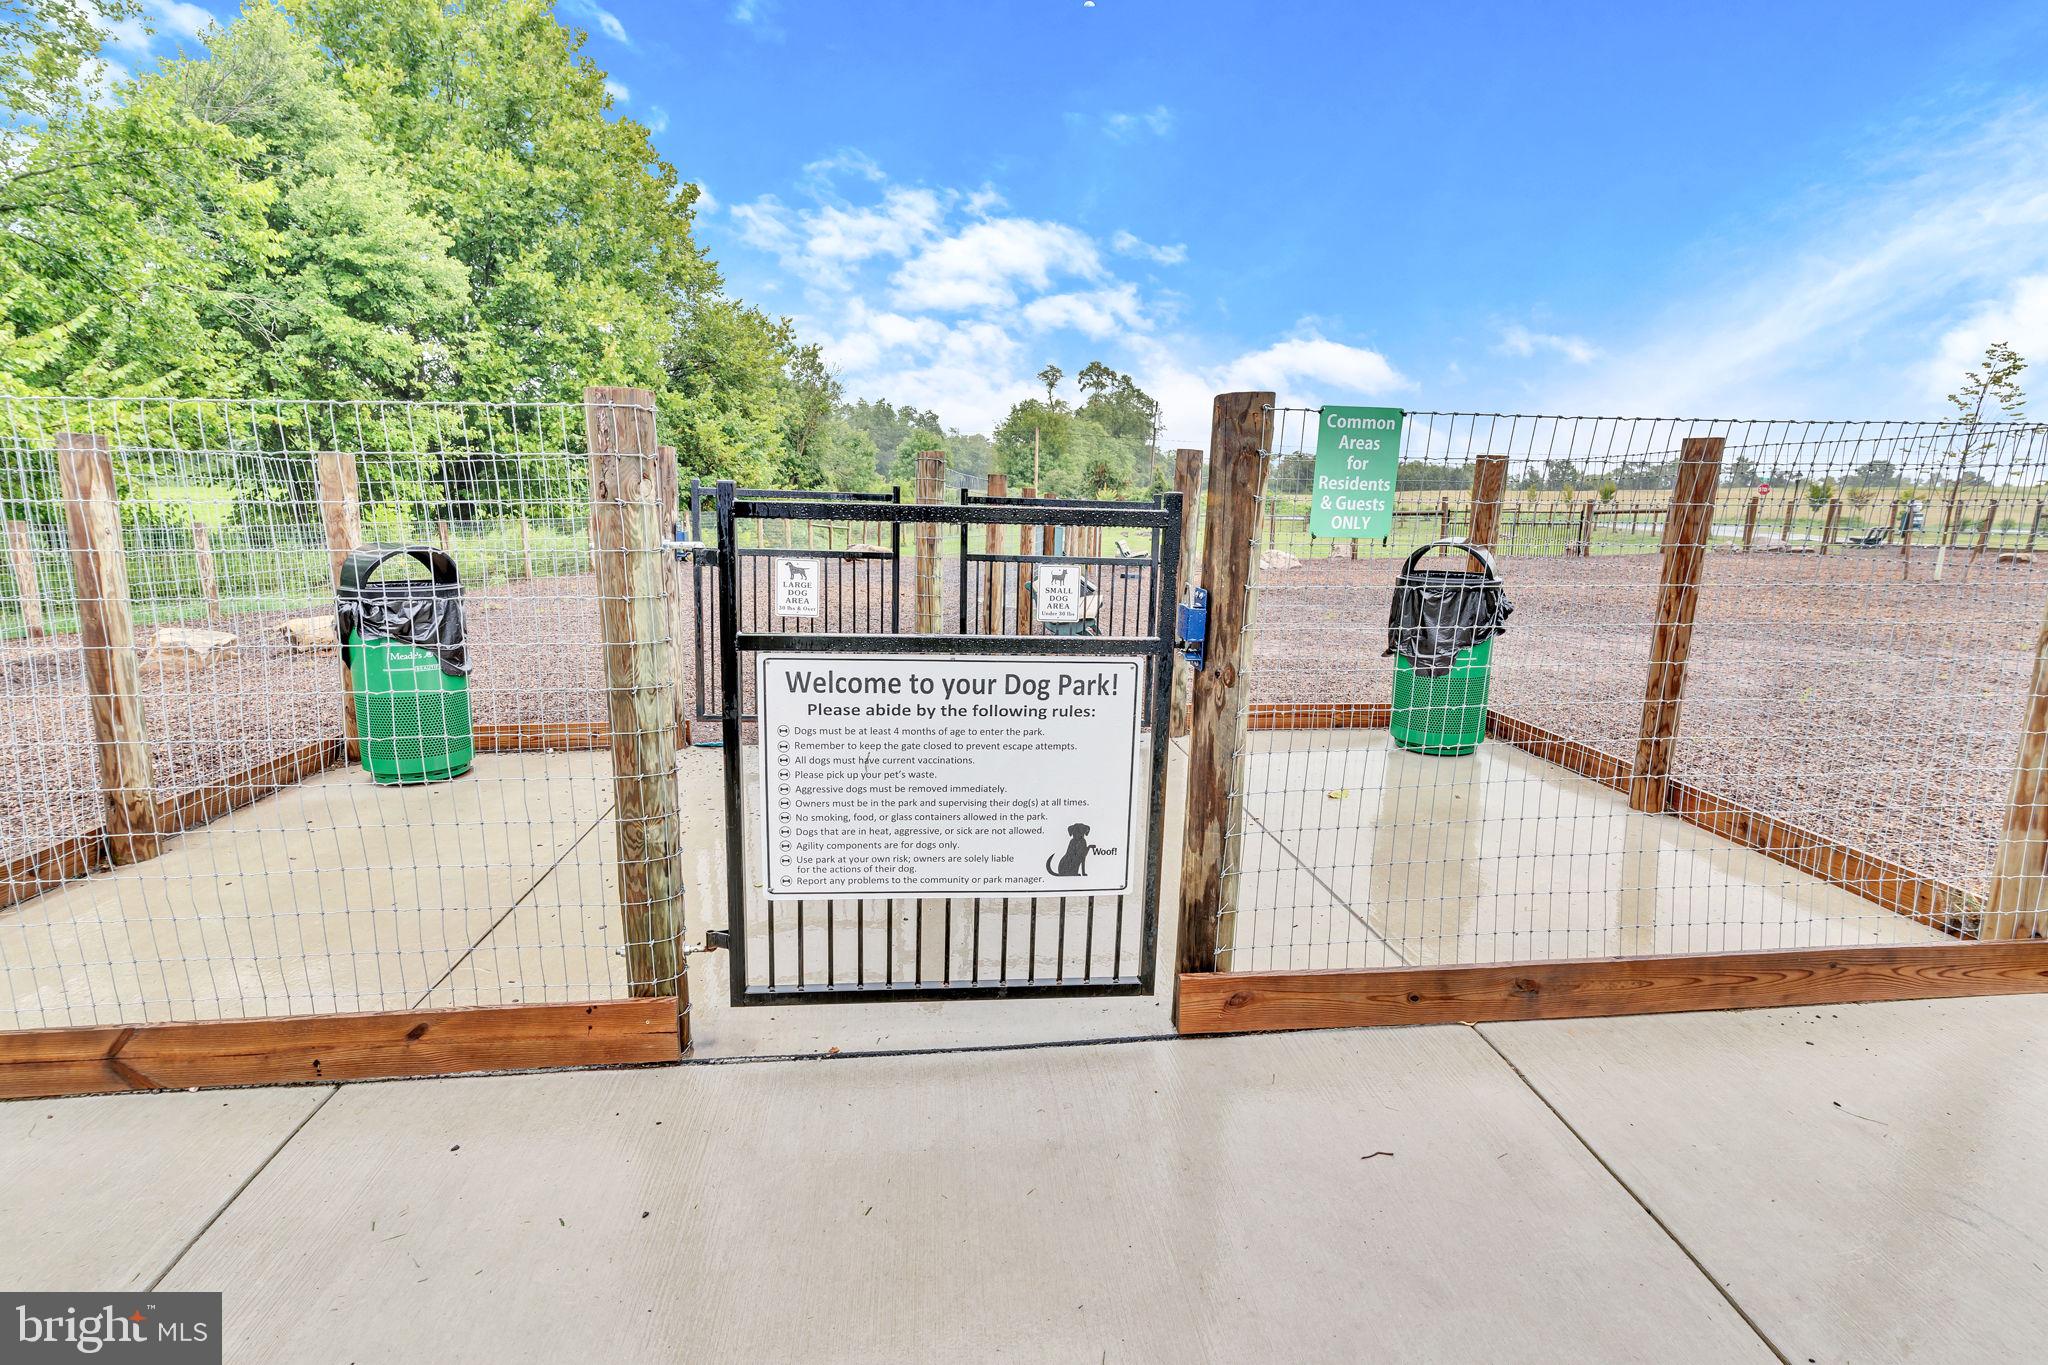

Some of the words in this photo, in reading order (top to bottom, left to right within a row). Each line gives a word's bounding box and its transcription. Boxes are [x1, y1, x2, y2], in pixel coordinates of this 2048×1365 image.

[1327, 414, 1396, 430] Common
[1338, 435, 1380, 450] Areas
[1346, 456, 1368, 470] for
[1318, 475, 1390, 491] Residents
[1321, 495, 1332, 510] &
[1336, 496, 1385, 511] Guests
[1331, 515, 1371, 530] ONLY
[786, 670, 901, 694] Welcome
[909, 674, 934, 694] to
[942, 678, 997, 700] your
[1005, 674, 1050, 700] Dog
[1059, 673, 1118, 696] Park!
[808, 703, 860, 716] Please
[866, 704, 911, 716] abide
[917, 704, 936, 719] by
[941, 704, 967, 716] the
[972, 704, 1047, 720] following
[1052, 705, 1095, 717] rules:
[795, 726, 817, 736] Dogs
[845, 727, 856, 735] be
[870, 727, 891, 735] least
[938, 727, 948, 736] of
[950, 729, 966, 737] age
[1006, 728, 1021, 736] the
[1023, 728, 1045, 737] park.
[795, 742, 845, 750] Remember
[860, 741, 882, 751] keep
[884, 742, 899, 750] the
[901, 743, 921, 752] gate
[923, 742, 952, 750] closed
[966, 743, 1000, 751] prevent
[1035, 743, 1078, 751] attempts.
[795, 756, 806, 764] All
[809, 756, 830, 766] dogs
[859, 756, 880, 765] have
[918, 756, 975, 764] vaccinations.
[827, 770, 844, 780] pick
[861, 772, 882, 780] your
[884, 770, 906, 780] pet's
[796, 785, 844, 795] Aggressive
[846, 785, 868, 795] dogs
[950, 785, 1007, 794] immediately.
[795, 800, 830, 808] Owners
[857, 799, 868, 807] be
[898, 799, 918, 808] park
[939, 799, 988, 808] supervising
[1012, 798, 1039, 808] dog(s)
[1052, 798, 1062, 806] all
[811, 814, 851, 823] smoking,
[854, 813, 877, 822] food,
[891, 813, 913, 823] glass
[1027, 813, 1048, 822] park.
[796, 828, 818, 837] Dogs
[869, 827, 892, 836] heat,
[894, 828, 942, 836] aggressive,
[1009, 826, 1044, 835] allowed.
[796, 842, 824, 851] Agility
[916, 841, 936, 850] dogs
[939, 841, 960, 850] only.
[816, 856, 835, 865] park
[893, 855, 910, 863] risk;
[964, 854, 989, 864] solely
[992, 854, 1014, 862] liable
[864, 864, 873, 873] of
[898, 865, 916, 874] dog.
[797, 877, 827, 886] Report
[848, 877, 890, 885] problems
[920, 876, 970, 884] community
[983, 876, 1002, 885] park
